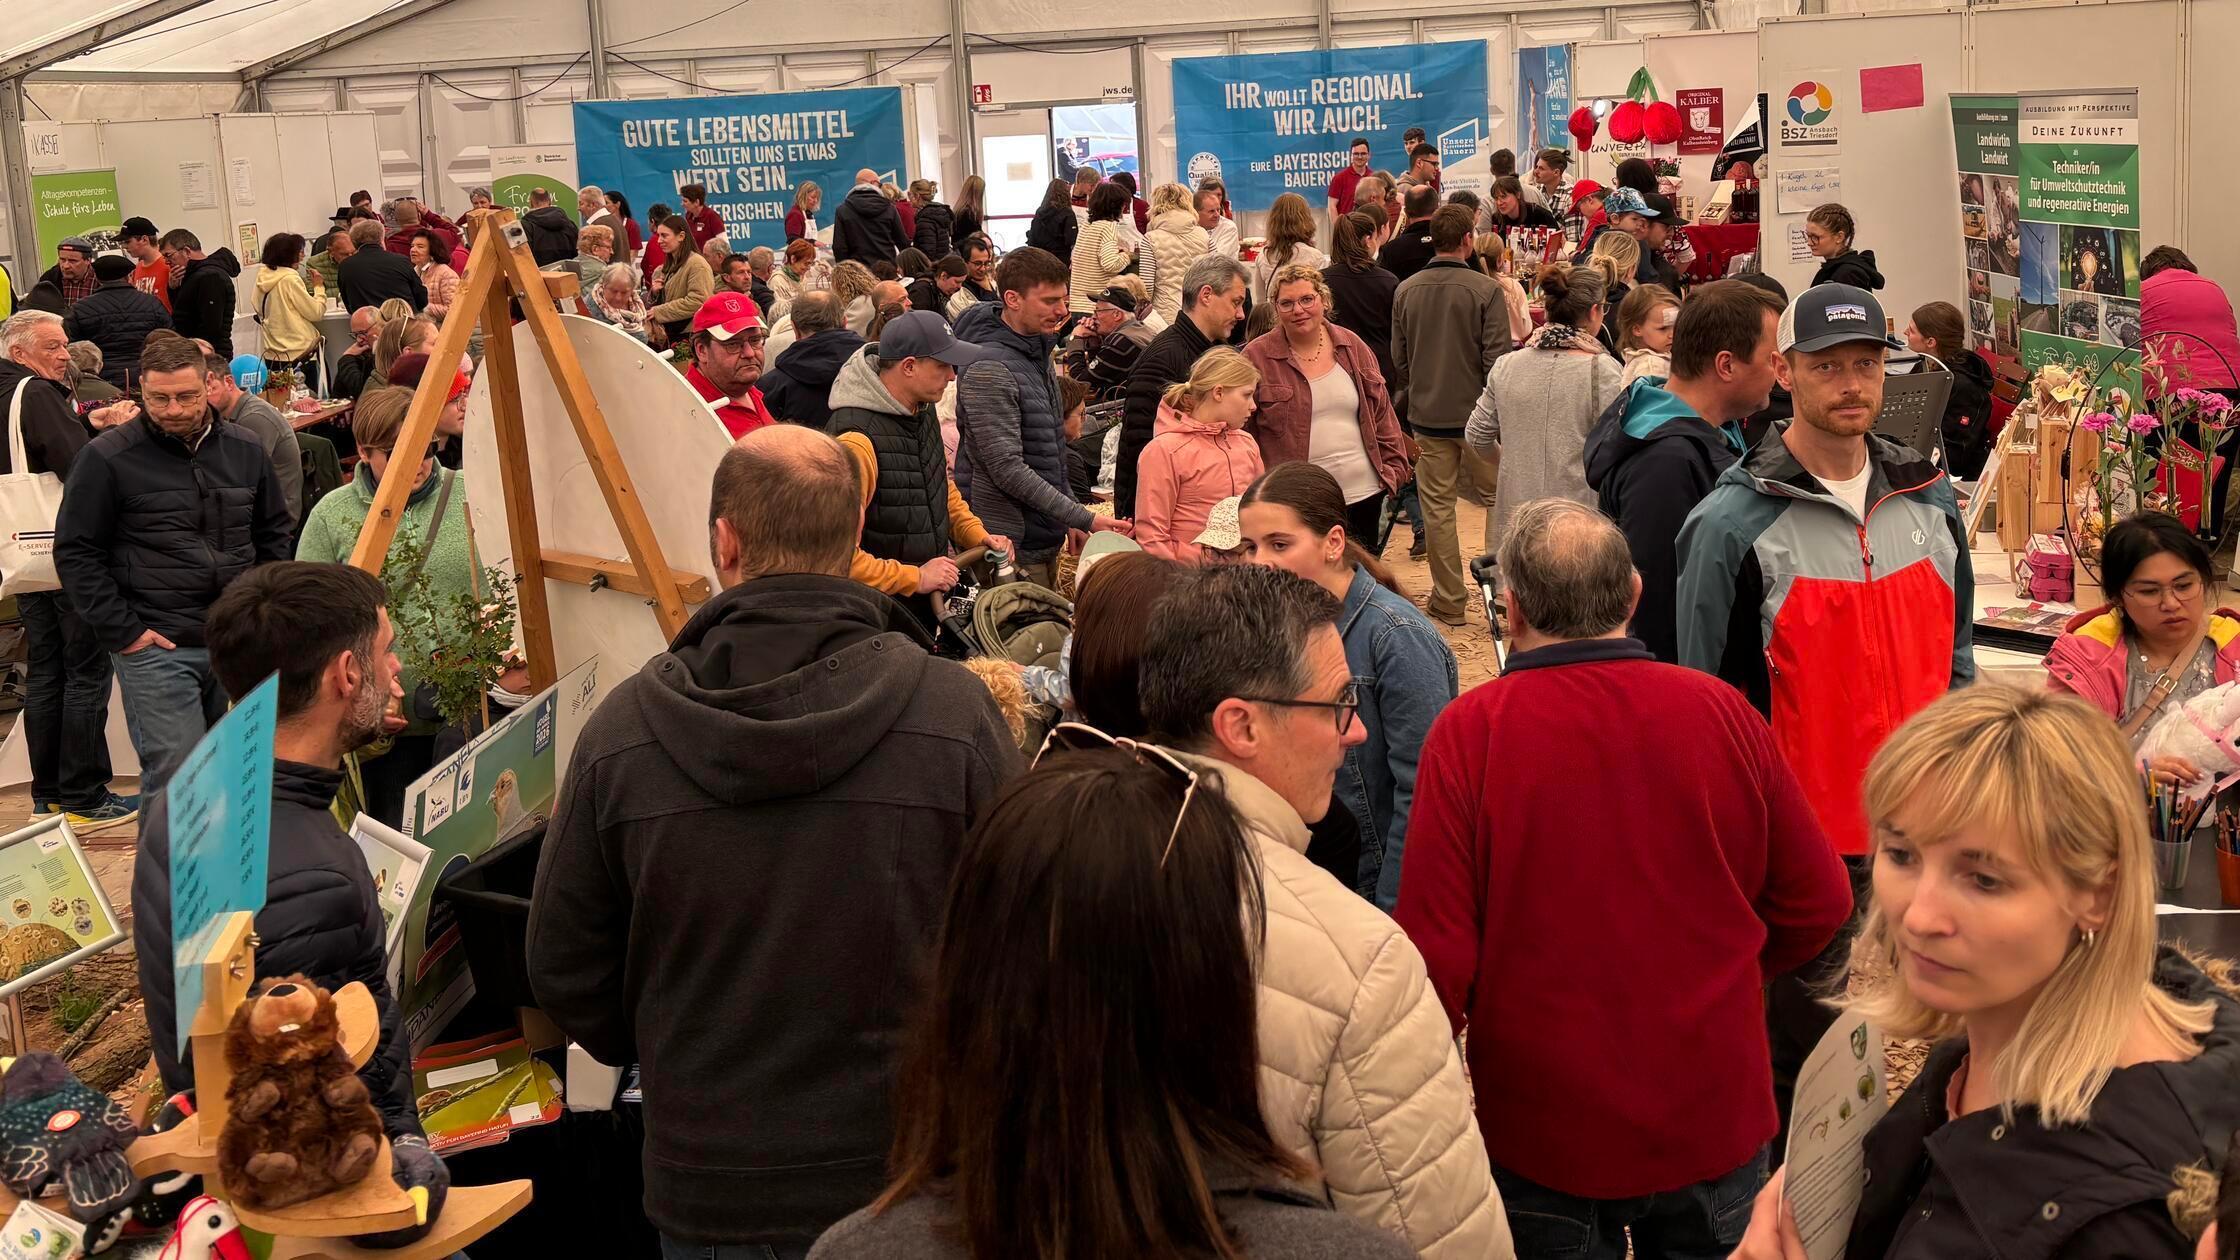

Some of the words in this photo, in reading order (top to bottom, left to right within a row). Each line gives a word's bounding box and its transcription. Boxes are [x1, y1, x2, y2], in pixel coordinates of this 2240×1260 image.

[1103, 86, 1132, 96] jws.de
[1225, 82, 1262, 109] IHR
[1264, 89, 1307, 107] WOLLT
[1311, 73, 1424, 105] REGIONAL.
[1680, 96, 1719, 105] KALBER
[2082, 104, 2131, 112] PERSPEKTIVE
[623, 118, 680, 147] GUTE
[687, 110, 854, 145] LEBENSMITTEL
[1274, 108, 1319, 136] WIR
[1322, 105, 1388, 133] AUCH.
[1782, 128, 1808, 139] BSZ
[2033, 126, 2065, 136] DEINE
[2071, 126, 2124, 136] ZUKUNFT
[1977, 132, 2011, 148] Landwirtin
[691, 147, 751, 166] SOLLTEN
[755, 144, 784, 162] UNS
[788, 142, 837, 162] ETWAS
[1251, 161, 1271, 172] EURE
[1274, 151, 1350, 171] BAYERISCH
[1981, 150, 2008, 166] Landwirt
[2053, 160, 2100, 175] Techniker/in
[672, 168, 730, 195] WERT
[736, 165, 794, 192] SEIN.
[2031, 178, 2040, 191] für
[2042, 178, 2126, 195] Umweltschutztechnik
[41, 187, 107, 201] Alltagskompetenzen
[43, 203, 70, 218] Schule
[73, 201, 89, 217] fürs
[92, 200, 115, 212] Leben
[2028, 196, 2042, 209] und
[2043, 198, 2091, 212] regenerative
[2093, 200, 2129, 217] Energien
[1828, 313, 1866, 322] patagonia
[19, 543, 52, 551] E-SERVIC
